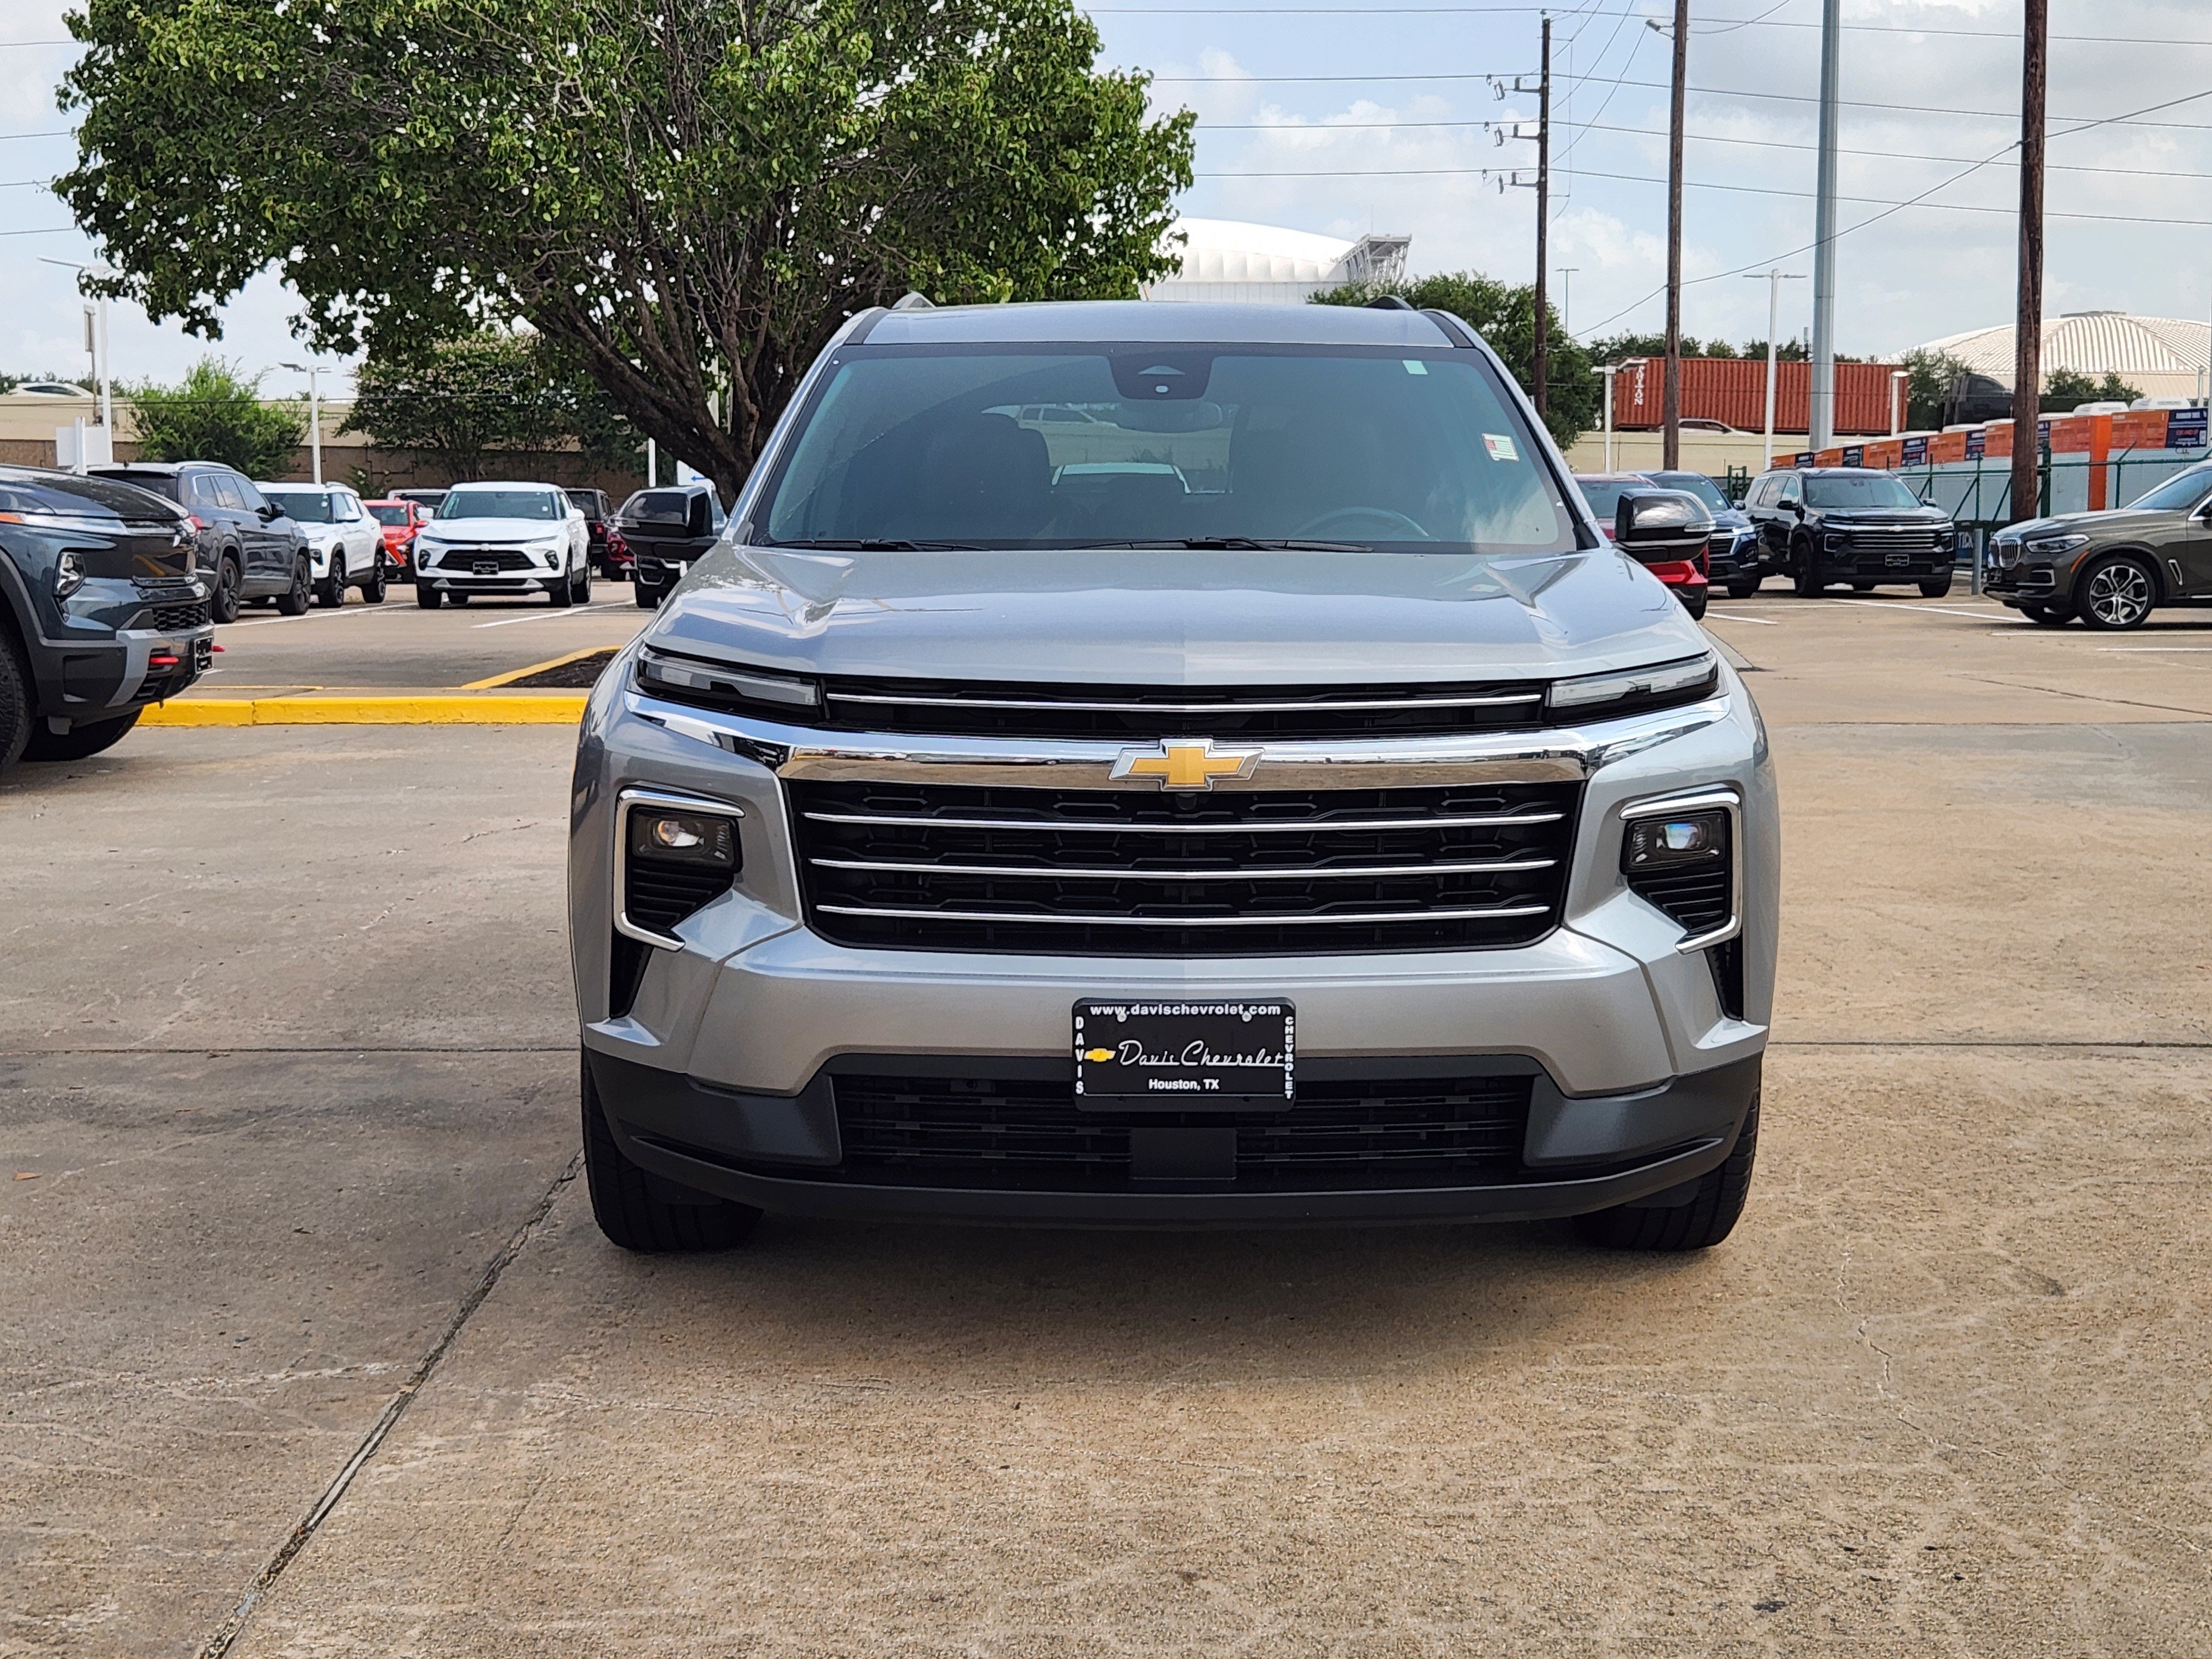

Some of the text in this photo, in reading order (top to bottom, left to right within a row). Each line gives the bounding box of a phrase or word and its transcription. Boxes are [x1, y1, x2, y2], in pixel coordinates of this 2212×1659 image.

[1090, 1003, 1281, 1015] www.davischevrolet.com
[1075, 1016, 1084, 1094] DAVIS
[1118, 1040, 1285, 1066] Davis Chevrolet
[1284, 1016, 1294, 1099] CHEVROLET
[1149, 1078, 1219, 1091] Houston, TX
